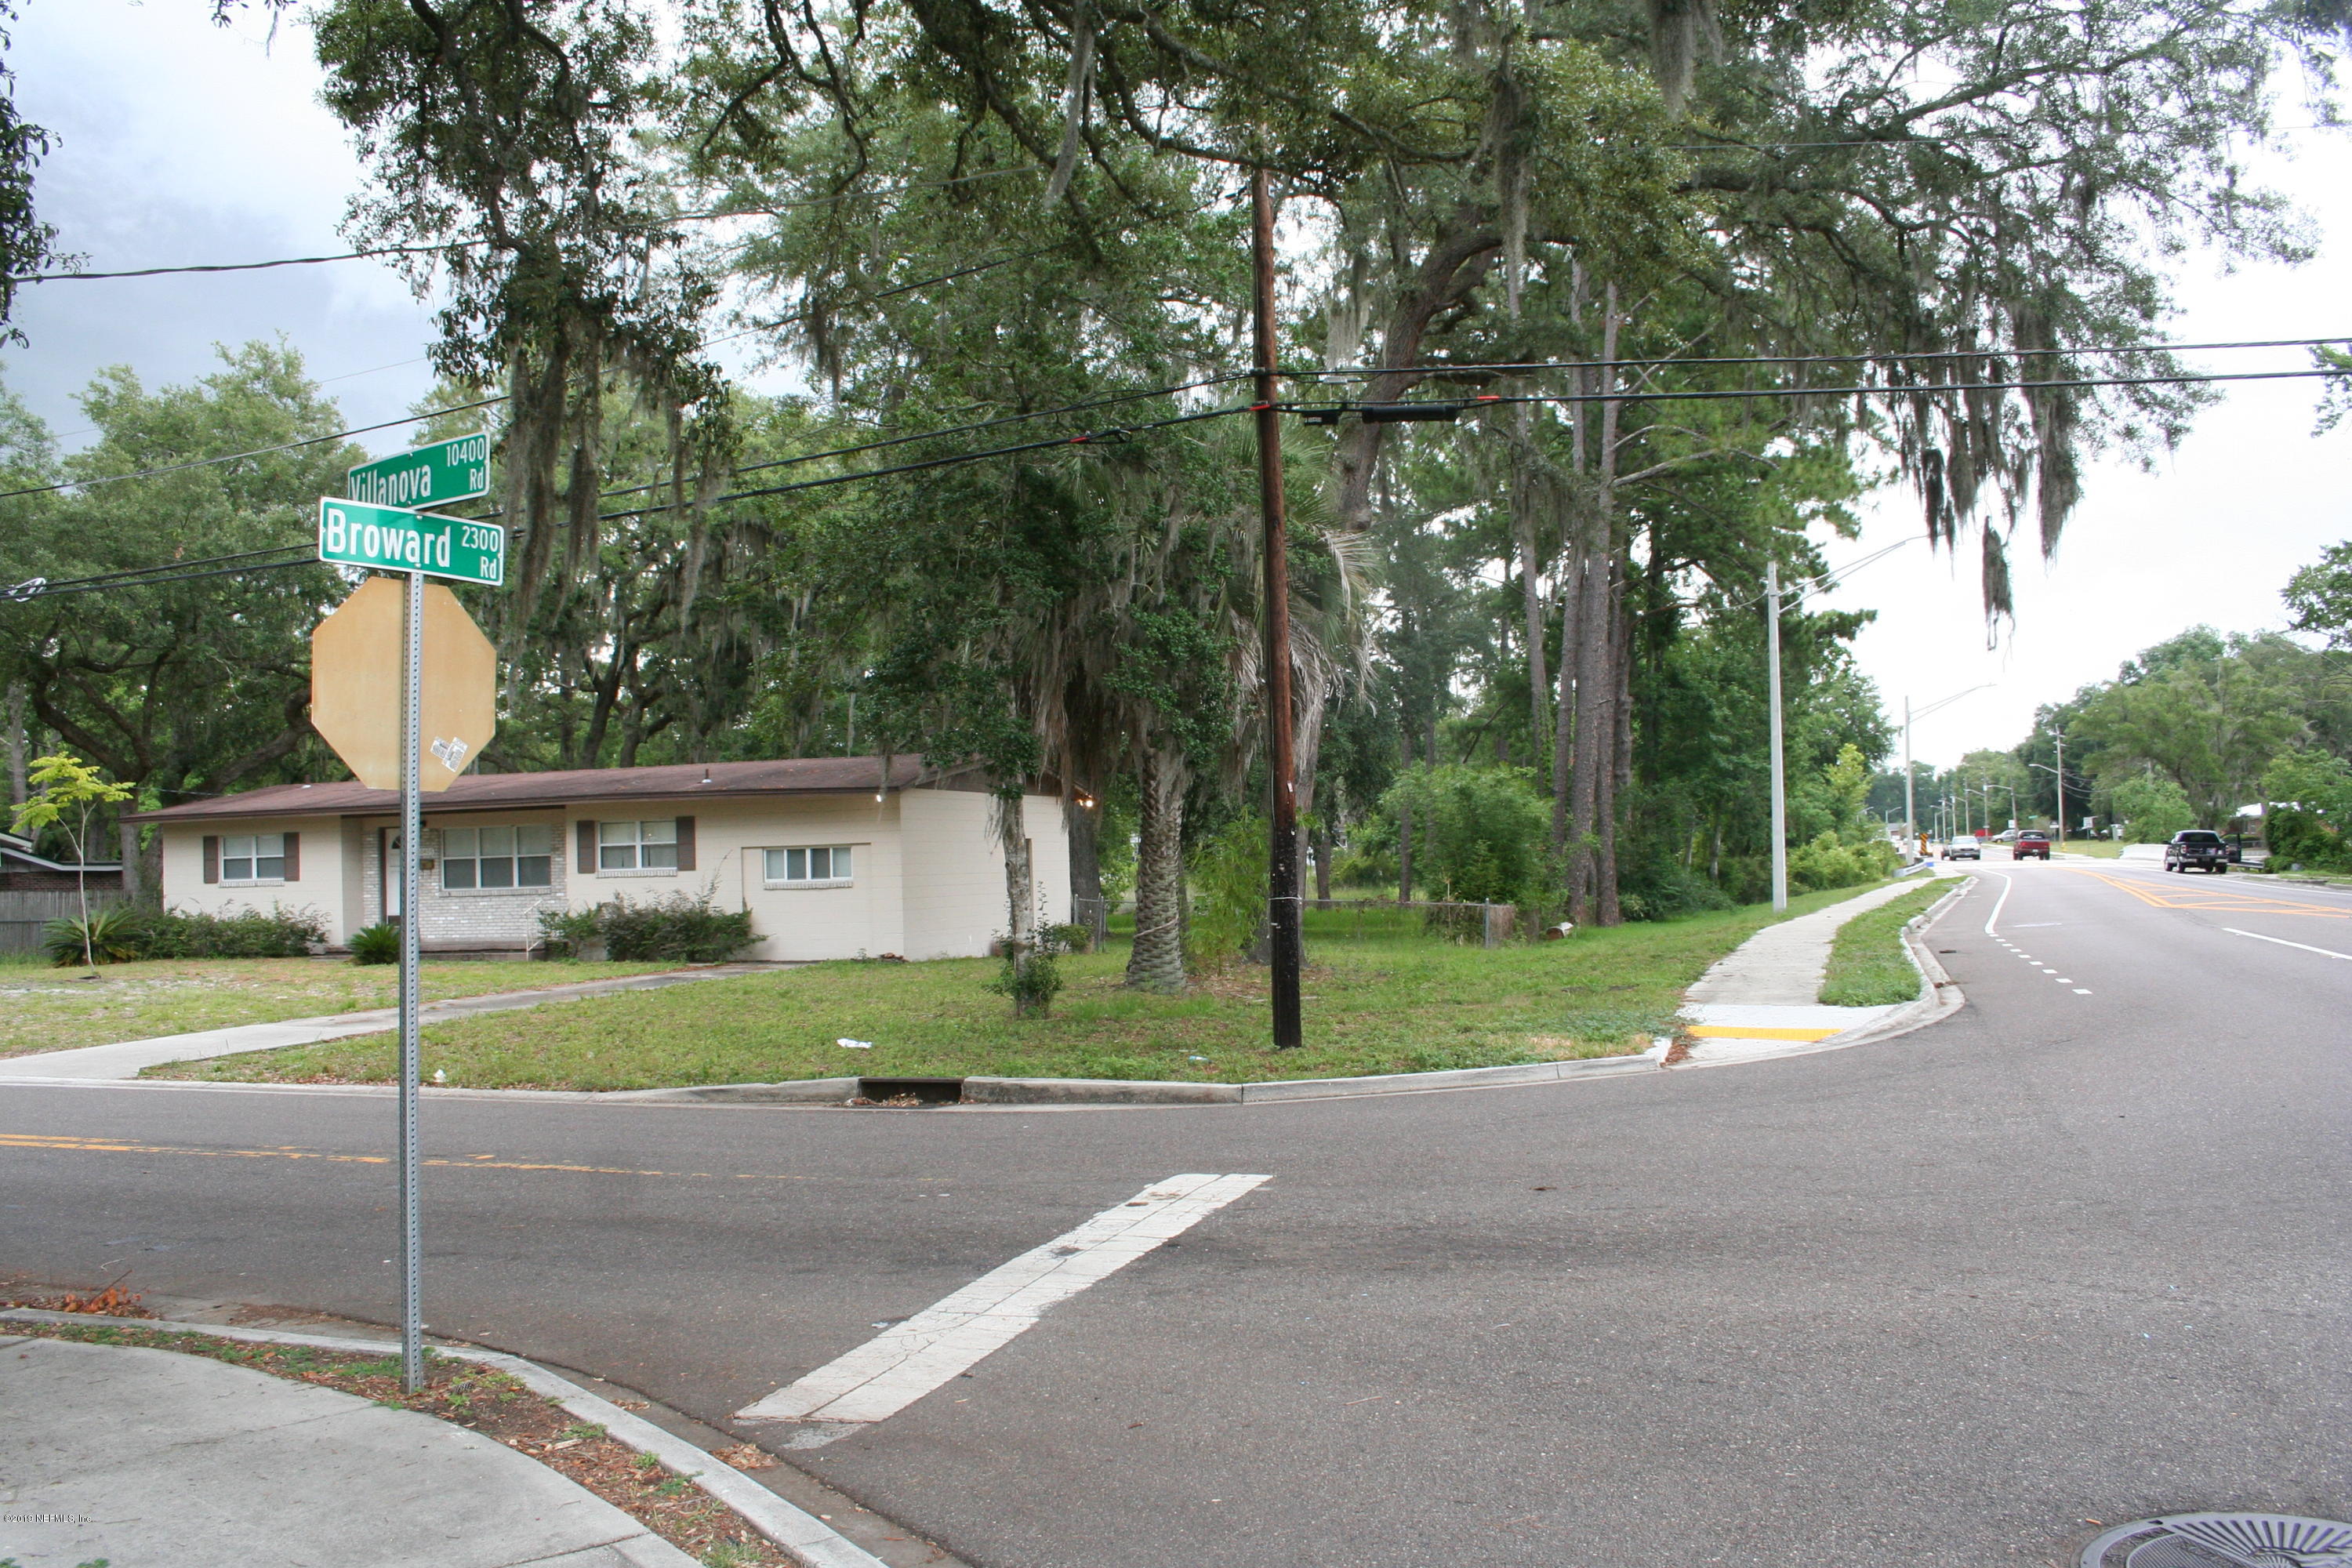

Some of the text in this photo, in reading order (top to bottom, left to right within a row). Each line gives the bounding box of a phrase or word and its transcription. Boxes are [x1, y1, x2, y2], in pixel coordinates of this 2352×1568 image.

[446, 437, 485, 467] 10400
[350, 464, 484, 506] Villanova Rd
[327, 507, 451, 568] Broward
[461, 525, 499, 552] 2300
[480, 556, 497, 579] Rd
